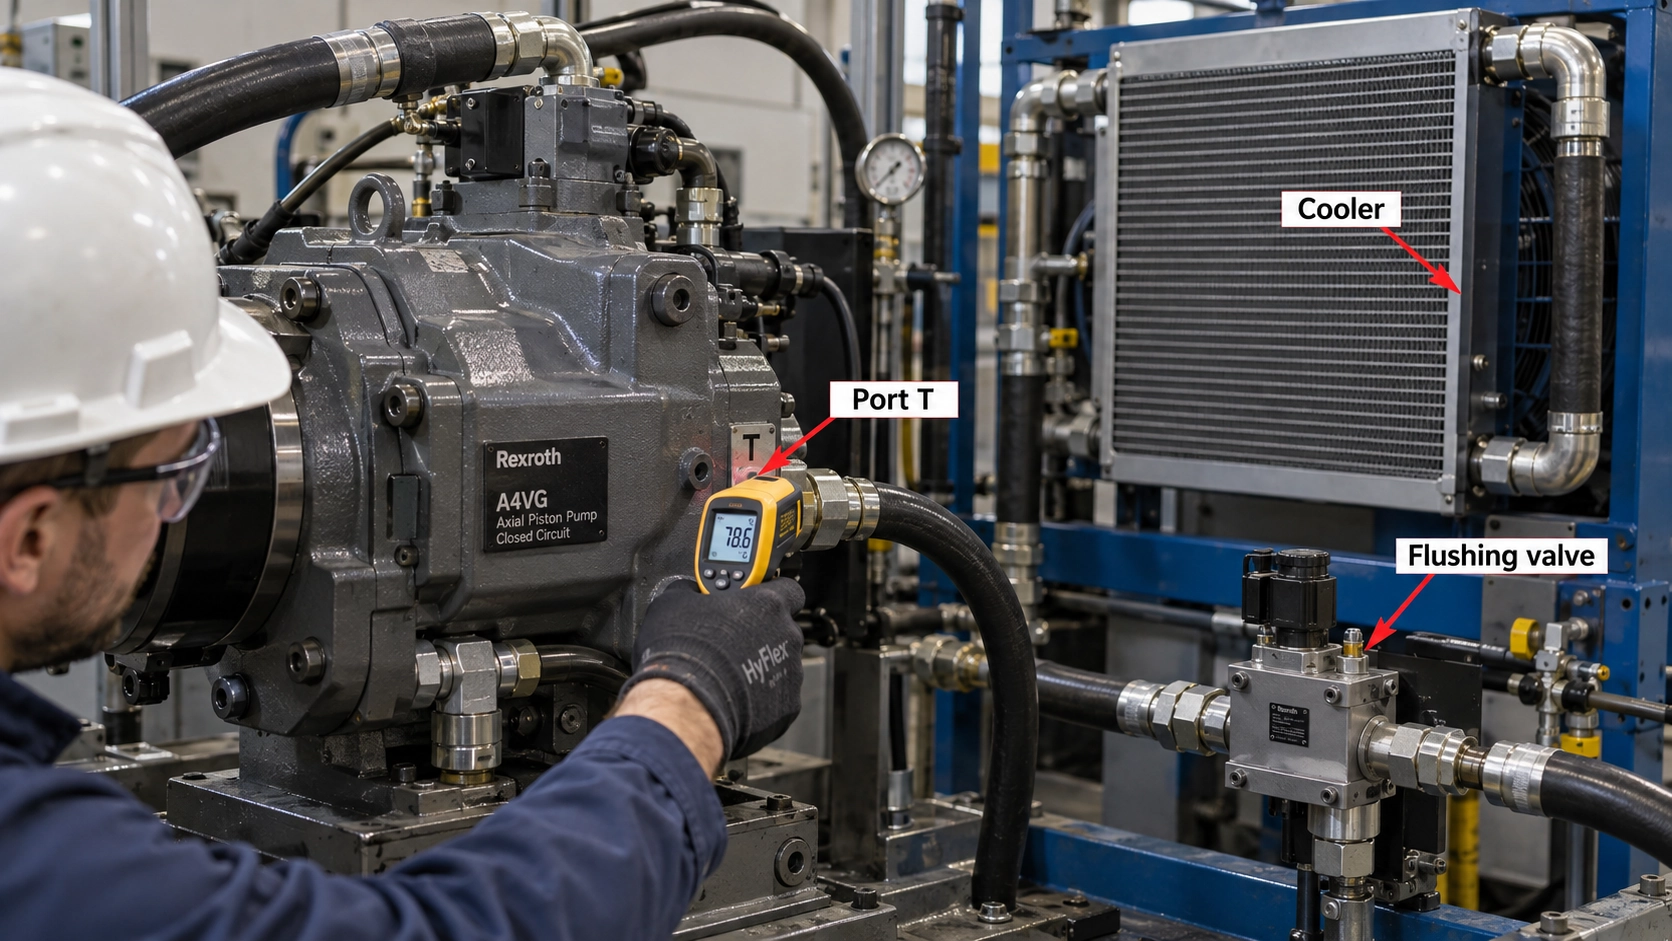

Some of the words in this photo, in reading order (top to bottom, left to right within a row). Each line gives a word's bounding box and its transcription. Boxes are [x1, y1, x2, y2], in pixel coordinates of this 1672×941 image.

[496, 447, 562, 469] Rexroth
[742, 433, 760, 461] T
[495, 489, 548, 512] A4VG
[496, 514, 525, 528] Axial
[528, 513, 563, 526] Piston
[566, 510, 598, 523] Pump
[496, 530, 533, 545] Closed
[536, 527, 571, 541] Circuit
[725, 526, 752, 549] 78.6
[741, 643, 789, 685] HyFlex
